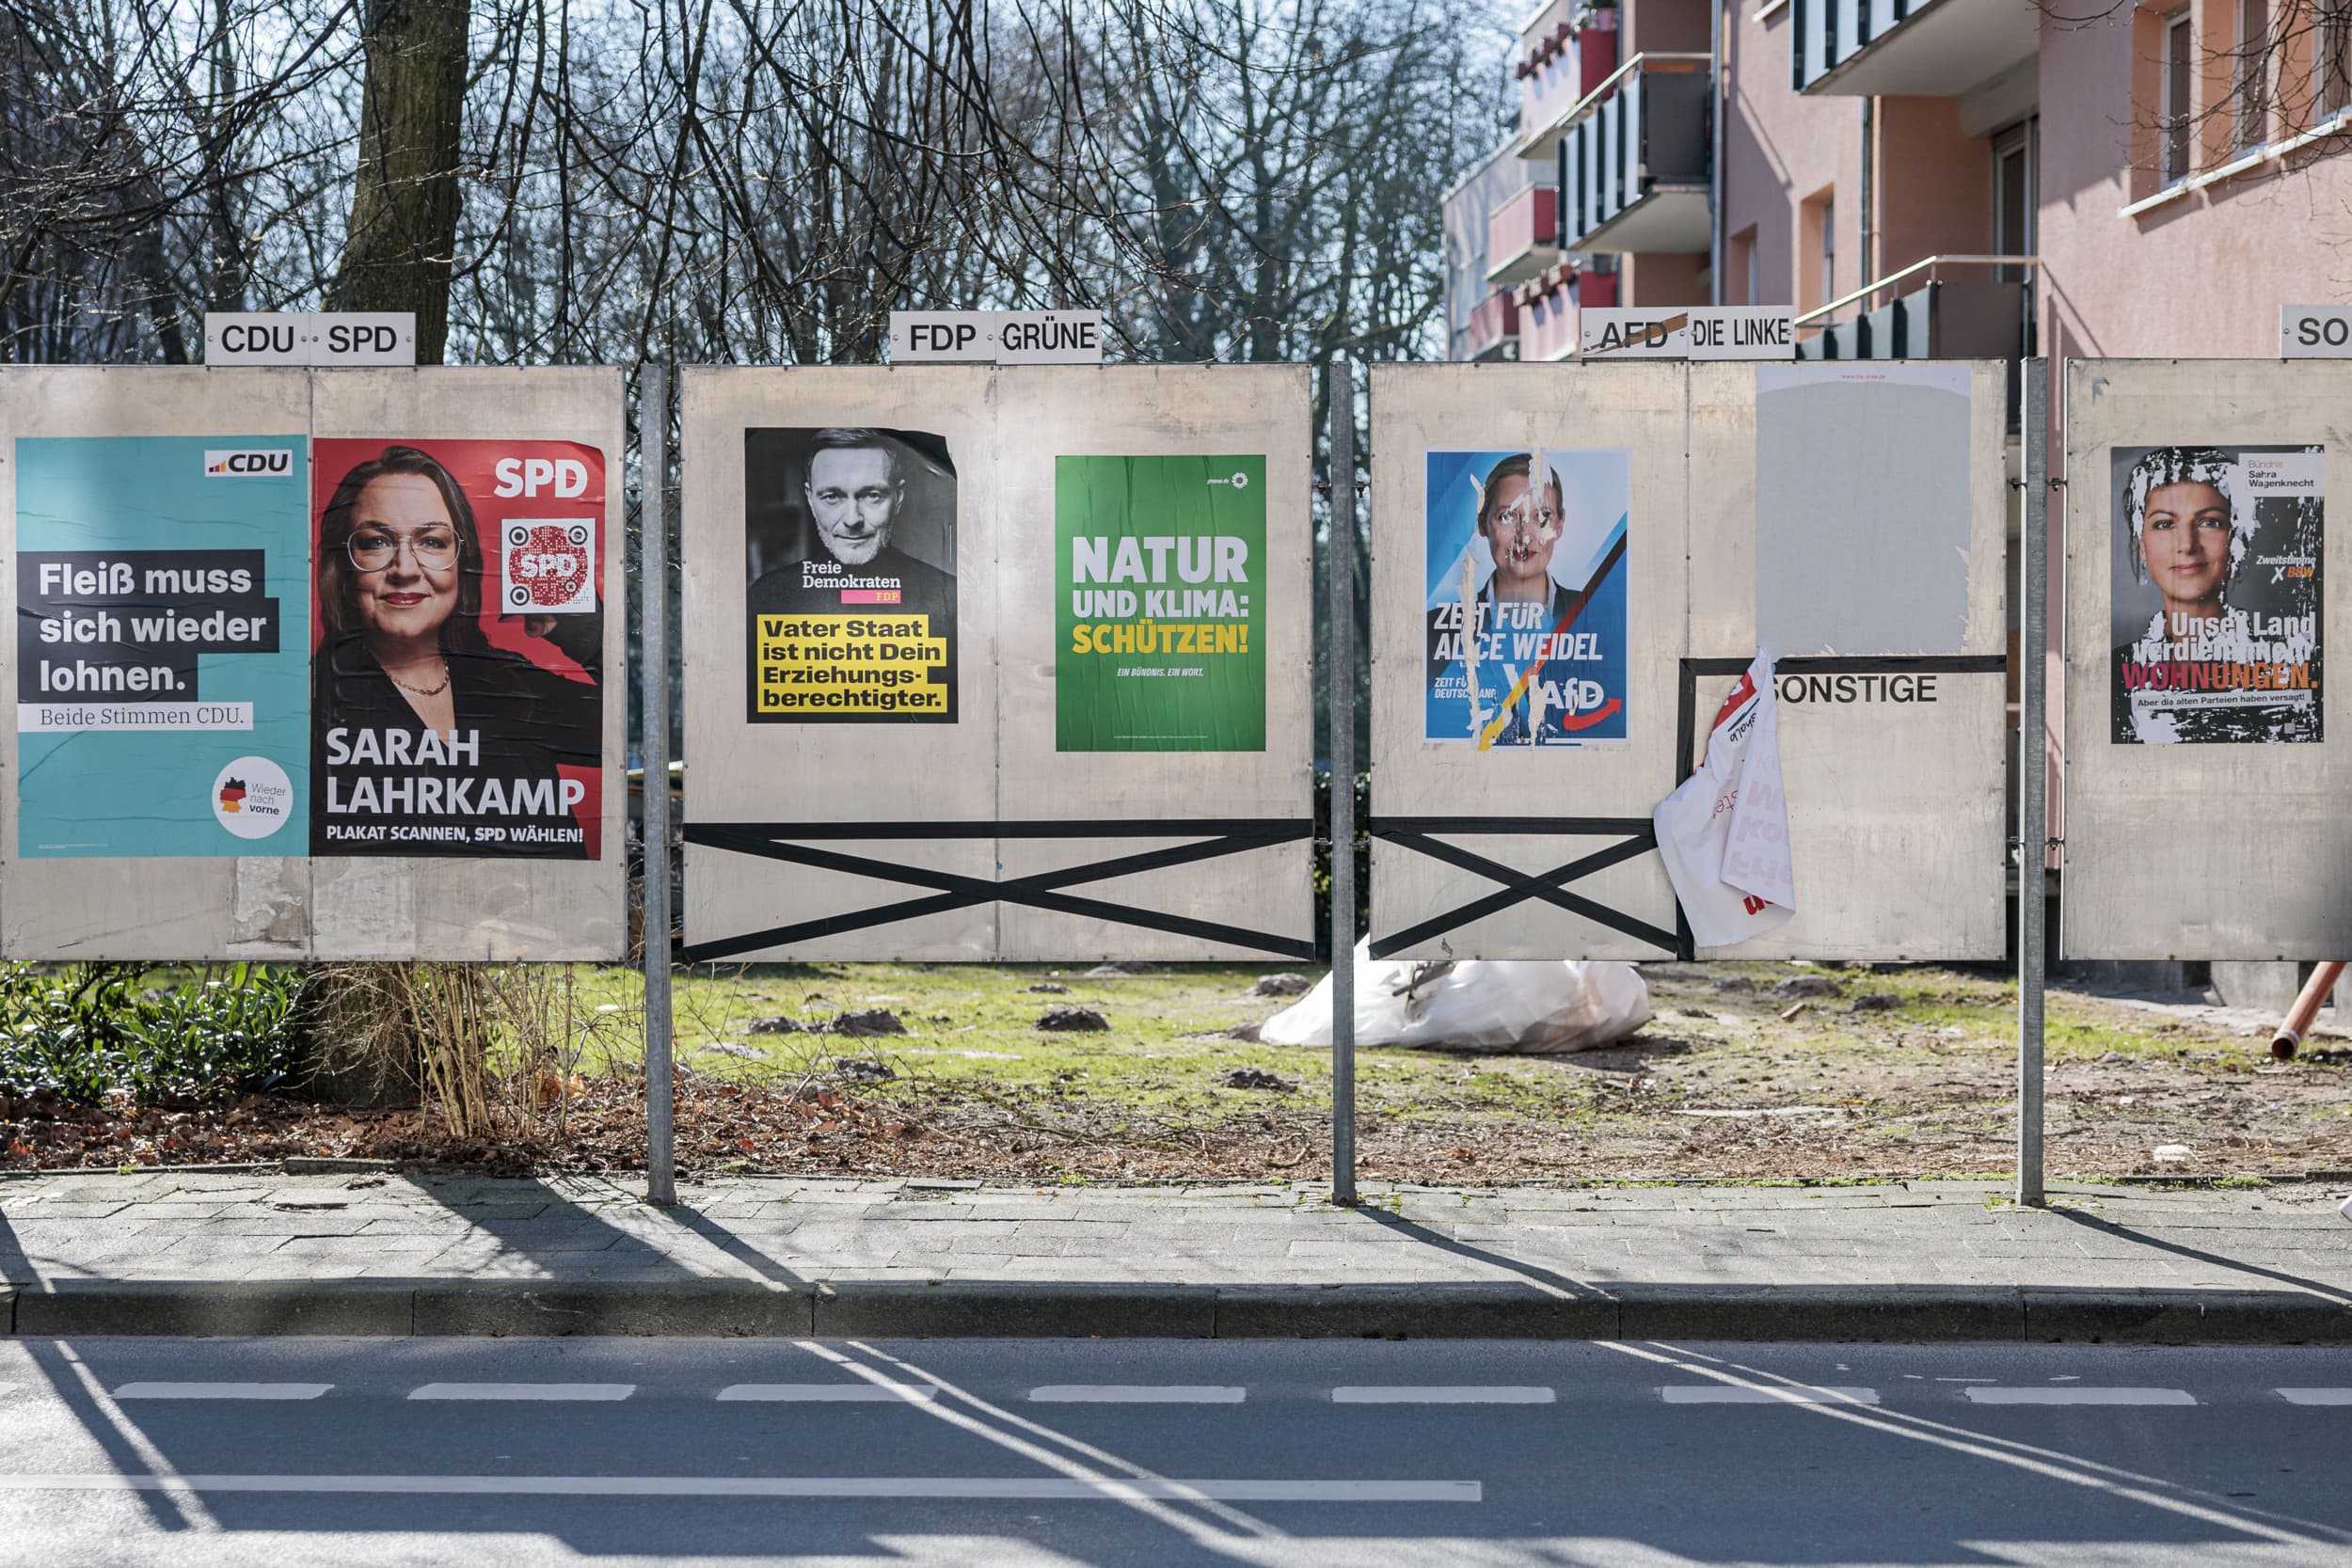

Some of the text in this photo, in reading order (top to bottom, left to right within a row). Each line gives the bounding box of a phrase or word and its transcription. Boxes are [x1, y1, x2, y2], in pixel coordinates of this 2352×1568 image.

[221, 325, 294, 353] CDU
[328, 325, 397, 353] SPD
[910, 325, 976, 351] FDP
[1003, 316, 1095, 350] GRÜNE
[1599, 322, 1668, 348] AFD
[1693, 318, 1788, 346] DIE LINKE
[2297, 317, 2352, 346] SO
[228, 454, 288, 472] CDU
[493, 458, 588, 498] SPD
[2249, 479, 2314, 488] Wagenknecht
[520, 554, 577, 578] SPD
[802, 561, 842, 574] Freie
[1073, 536, 1249, 583] NATUR
[2256, 555, 2316, 564] Zweitstimme
[2287, 566, 2314, 578] BSW
[40, 562, 252, 594] Fleiß muss
[802, 575, 901, 589] Demokraten
[876, 593, 898, 601] FDP
[1073, 590, 1249, 617] UND KLIMA:
[40, 609, 266, 642] sich wieder
[1434, 602, 1545, 629] ZET FÜR
[2254, 611, 2316, 636] Land
[763, 620, 923, 637] Vater Staat
[1072, 618, 1249, 654] SCHÜTZEN!
[763, 642, 941, 660] ist nicht Dein
[1434, 633, 1603, 660] ALCE WEIDEL
[40, 660, 185, 691] lohnen.
[763, 666, 922, 687] Erziehungs-
[1117, 666, 1204, 676] EIN BÜNDNIS. EIN WORT.
[1435, 675, 1468, 688] ZEIT FÜ
[2122, 662, 2318, 689] WOHNUNGEN.
[763, 689, 942, 710] berechtigter.
[1544, 677, 1605, 709] AfD
[1773, 675, 1937, 704] ONSTIGE
[2137, 692, 2306, 707] Aber die alten Parteien haben versagt!
[40, 707, 244, 725] Beide Stimmen CDU.
[326, 728, 479, 766] SARAH
[250, 795, 274, 804] nach
[251, 783, 286, 797] Wieder
[326, 777, 585, 816] LAHRKAMP
[249, 804, 279, 815] vorne
[326, 825, 583, 843] PLAKAT SCANNEN, SPD WÄHLEN!
